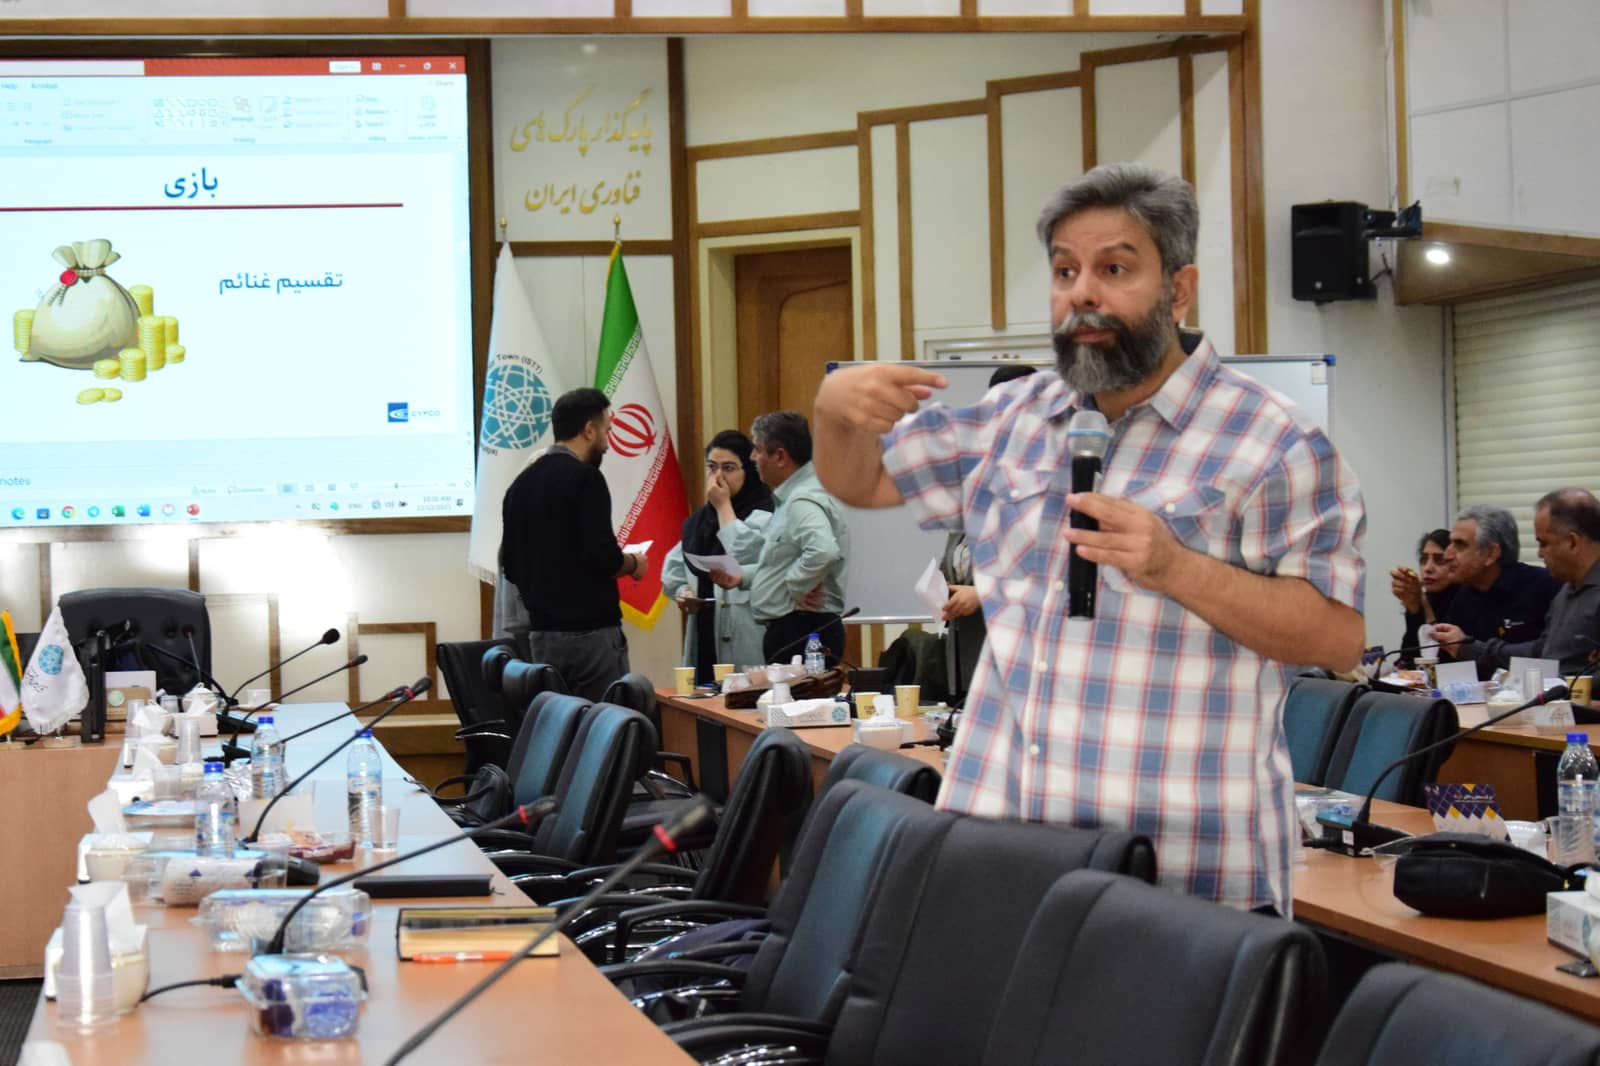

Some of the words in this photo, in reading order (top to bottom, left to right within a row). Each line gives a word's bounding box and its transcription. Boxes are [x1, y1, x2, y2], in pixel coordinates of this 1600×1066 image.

[164, 168, 218, 198] بازی
[579, 169, 642, 215] فناوری
[524, 182, 576, 215] ایران
[219, 272, 272, 295] غنائم
[277, 271, 343, 295] تقسیم
[0, 477, 30, 486] notes
